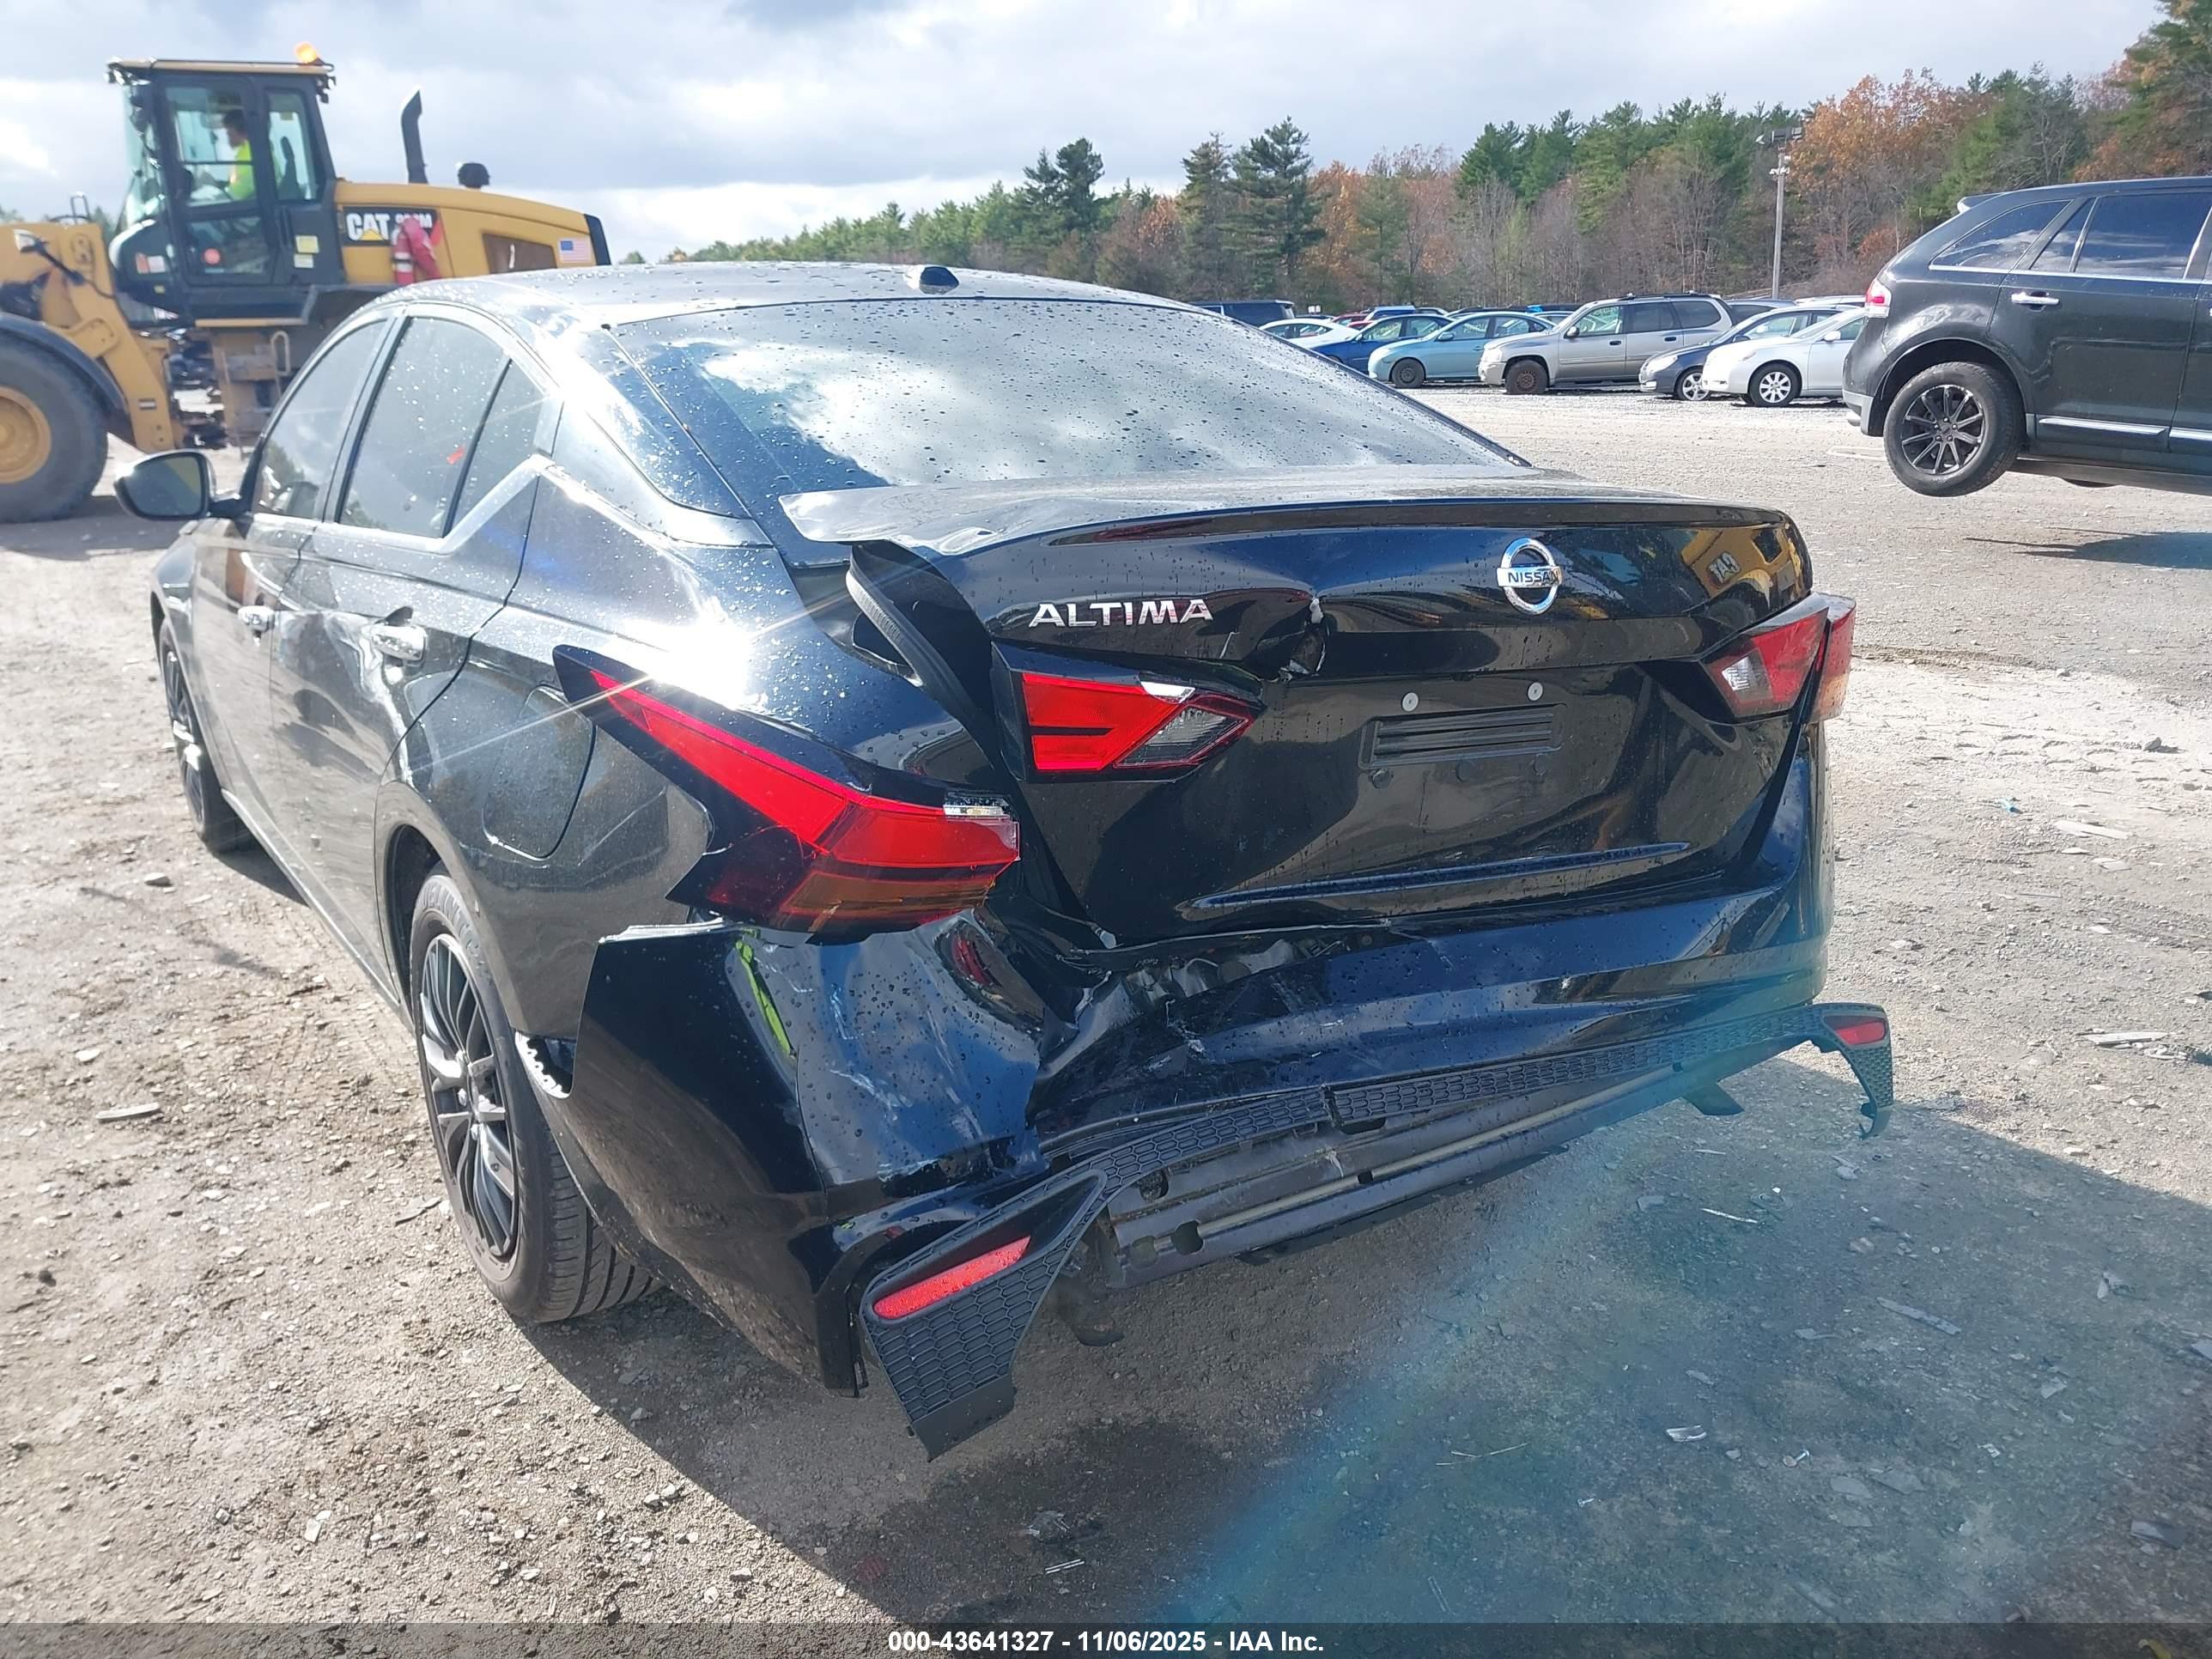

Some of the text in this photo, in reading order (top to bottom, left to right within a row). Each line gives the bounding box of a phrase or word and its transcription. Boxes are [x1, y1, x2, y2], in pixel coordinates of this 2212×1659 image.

[346, 213, 391, 240] CAT
[1508, 569, 1559, 584] NISSAN
[1029, 599, 1214, 628] ALTIMA
